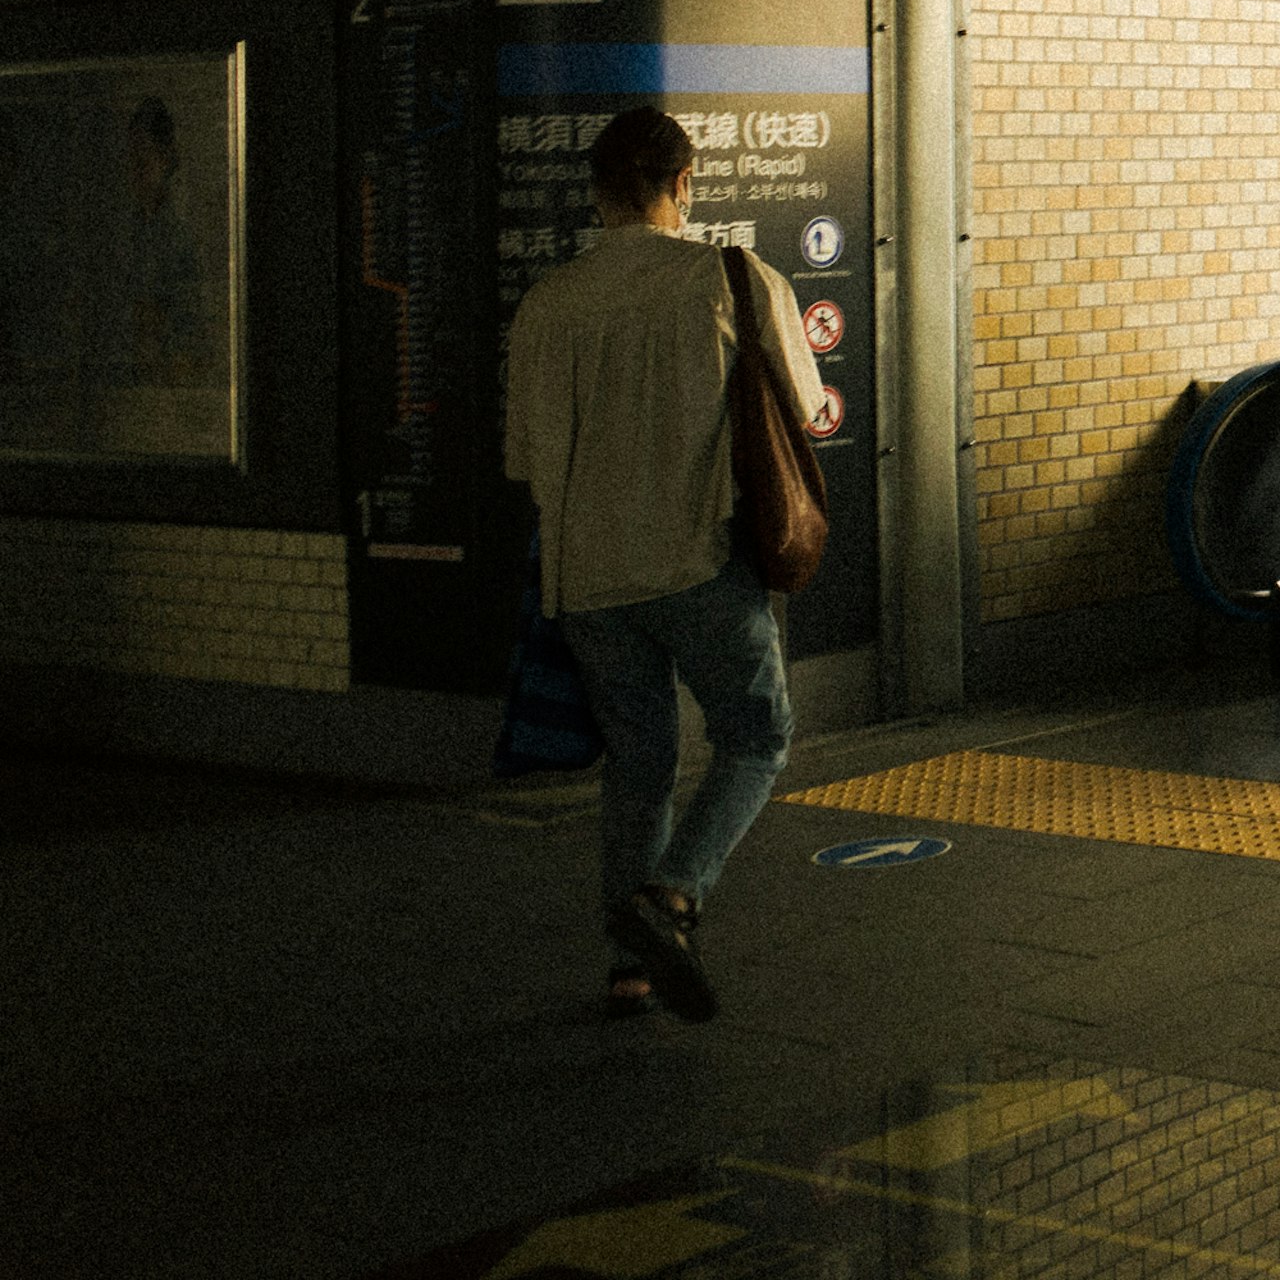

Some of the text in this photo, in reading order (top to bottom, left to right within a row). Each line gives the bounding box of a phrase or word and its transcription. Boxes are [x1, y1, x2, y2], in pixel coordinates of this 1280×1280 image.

[691, 155, 734, 178] Line
[737, 152, 807, 181] (Rapid)
[355, 490, 371, 537] 1
